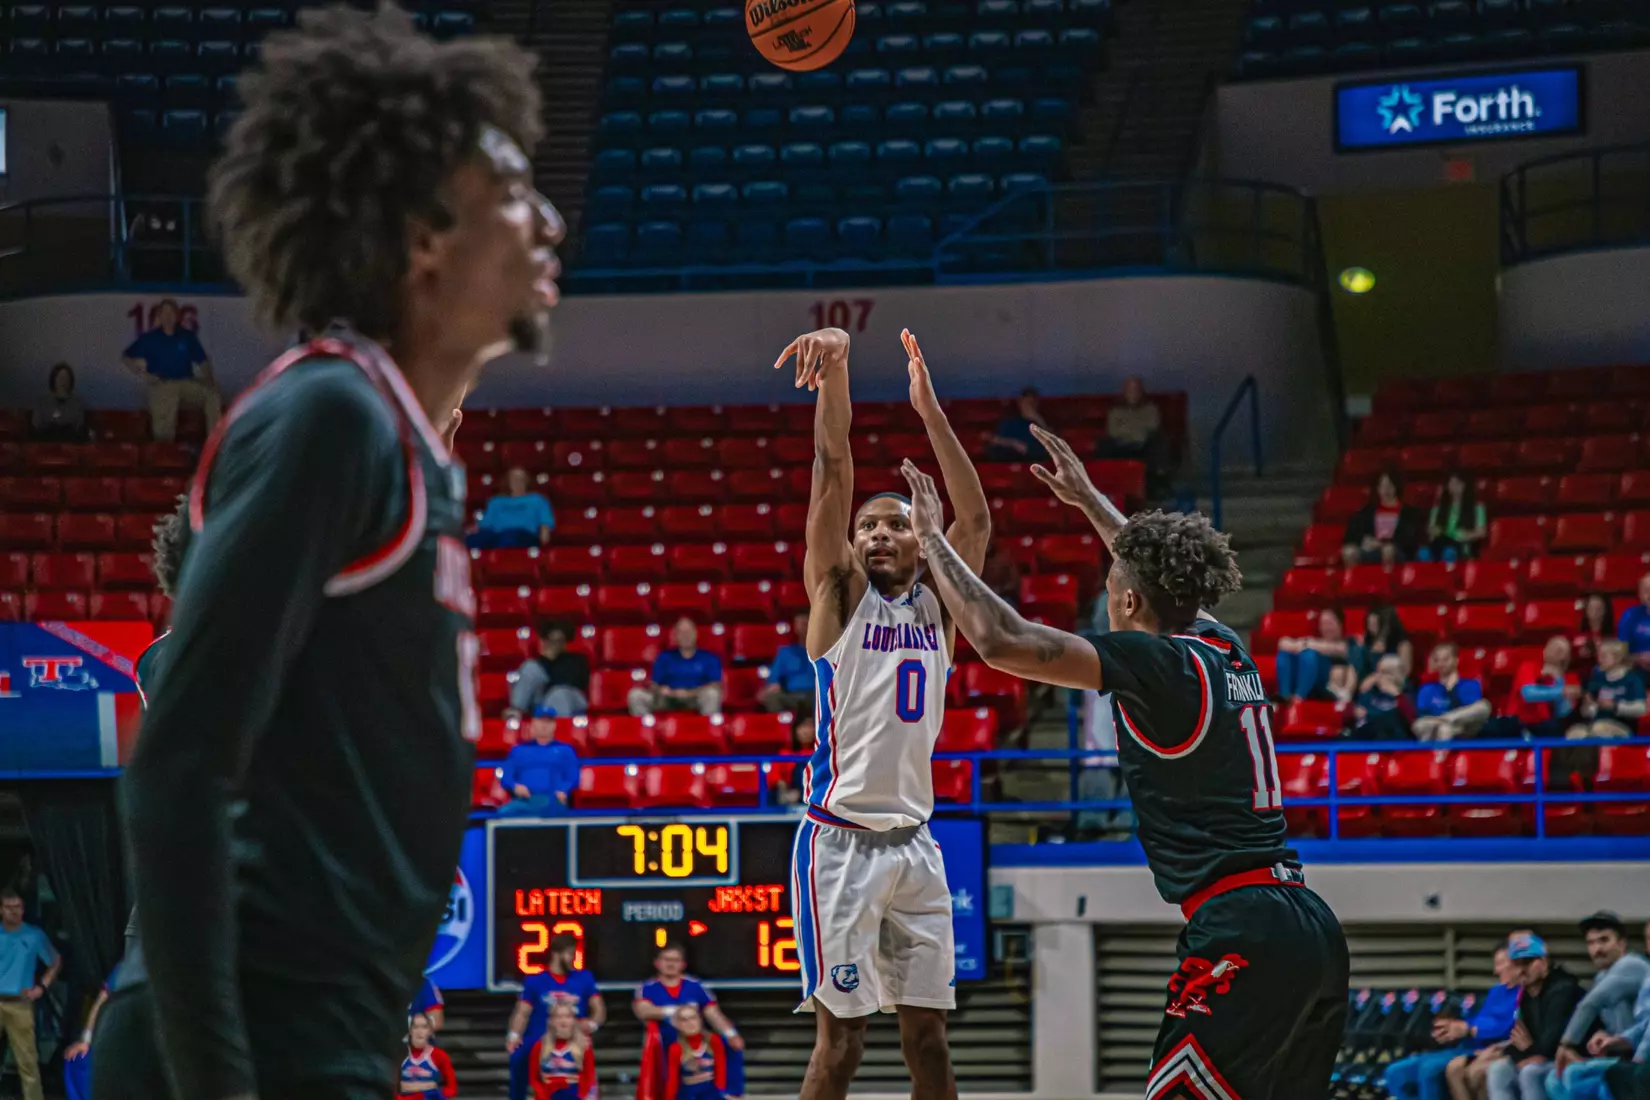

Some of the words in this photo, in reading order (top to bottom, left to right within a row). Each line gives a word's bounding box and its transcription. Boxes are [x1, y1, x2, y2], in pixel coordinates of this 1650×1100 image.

[1432, 85, 1534, 125] Forth
[808, 299, 876, 333] 107
[896, 658, 927, 723] 0
[1239, 704, 1283, 811] 11
[616, 824, 728, 877] 7:04
[622, 901, 683, 921] PERIOD
[757, 916, 801, 970] 12
